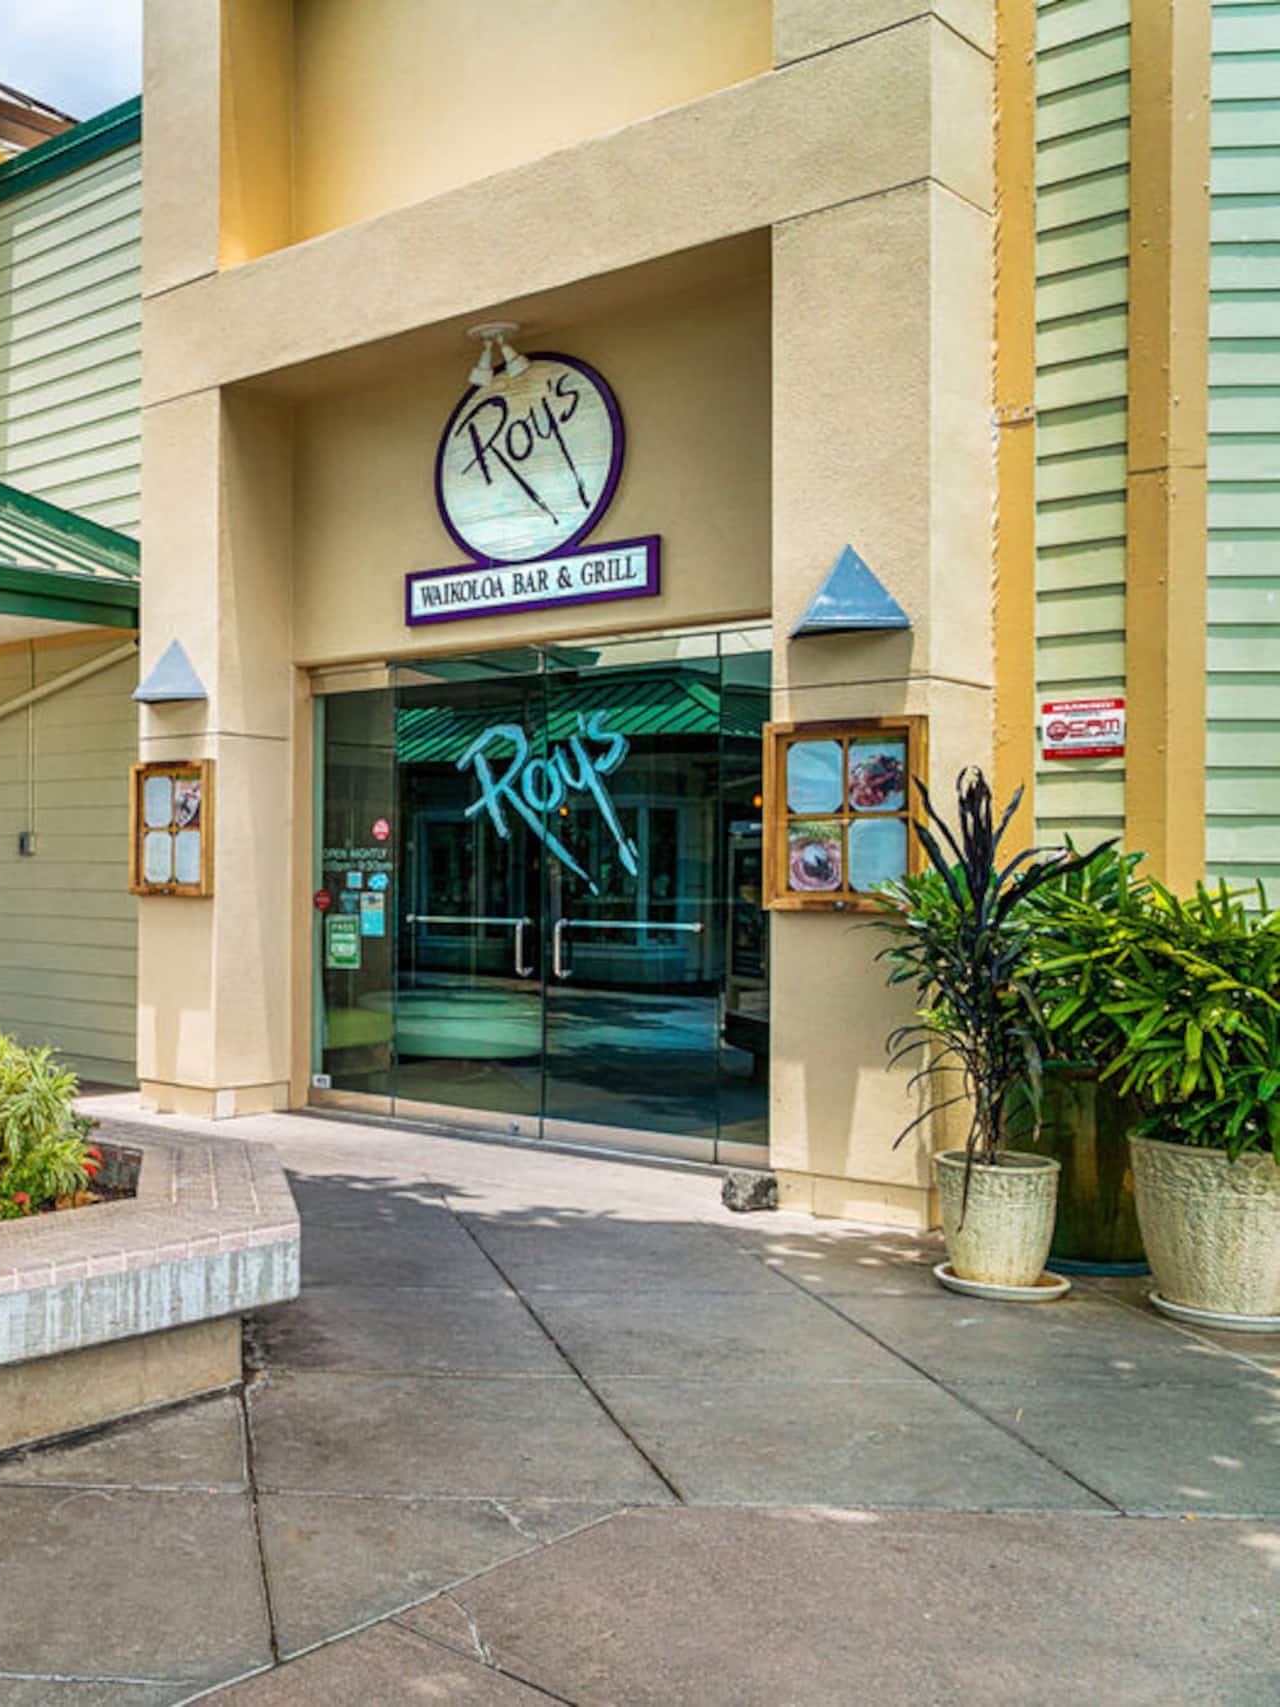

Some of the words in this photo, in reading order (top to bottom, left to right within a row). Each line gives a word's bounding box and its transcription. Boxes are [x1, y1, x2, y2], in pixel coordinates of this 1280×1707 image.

[455, 373, 590, 525] Roy's
[421, 577, 505, 608] WAIKOLOA
[512, 570, 549, 596] BAR
[557, 566, 573, 589] &
[580, 555, 637, 586] GRILL
[456, 709, 638, 896] Roy's
